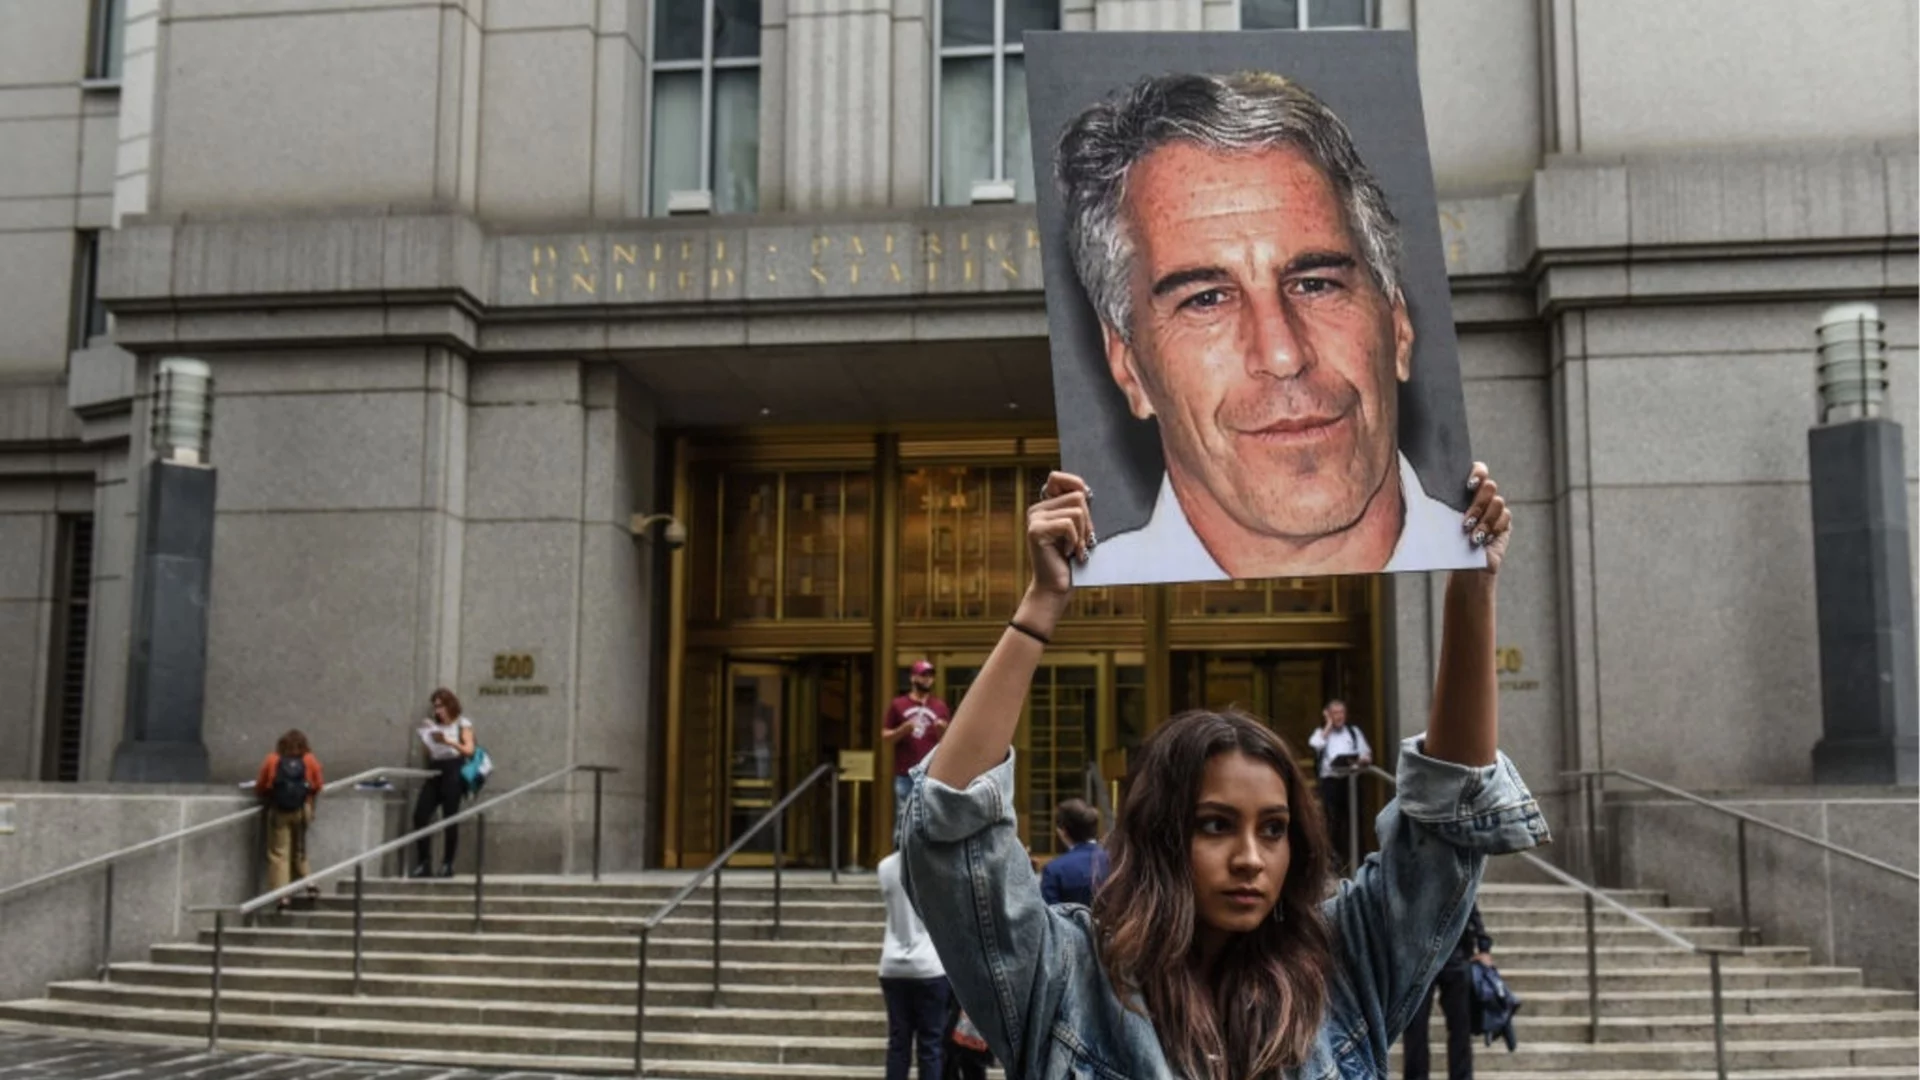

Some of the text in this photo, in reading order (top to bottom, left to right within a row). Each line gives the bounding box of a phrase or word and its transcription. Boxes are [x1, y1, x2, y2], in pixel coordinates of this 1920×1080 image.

[532, 239, 728, 266] DANIEL
[530, 260, 1019, 296] UNITED STATES
[493, 654, 534, 680] 500
